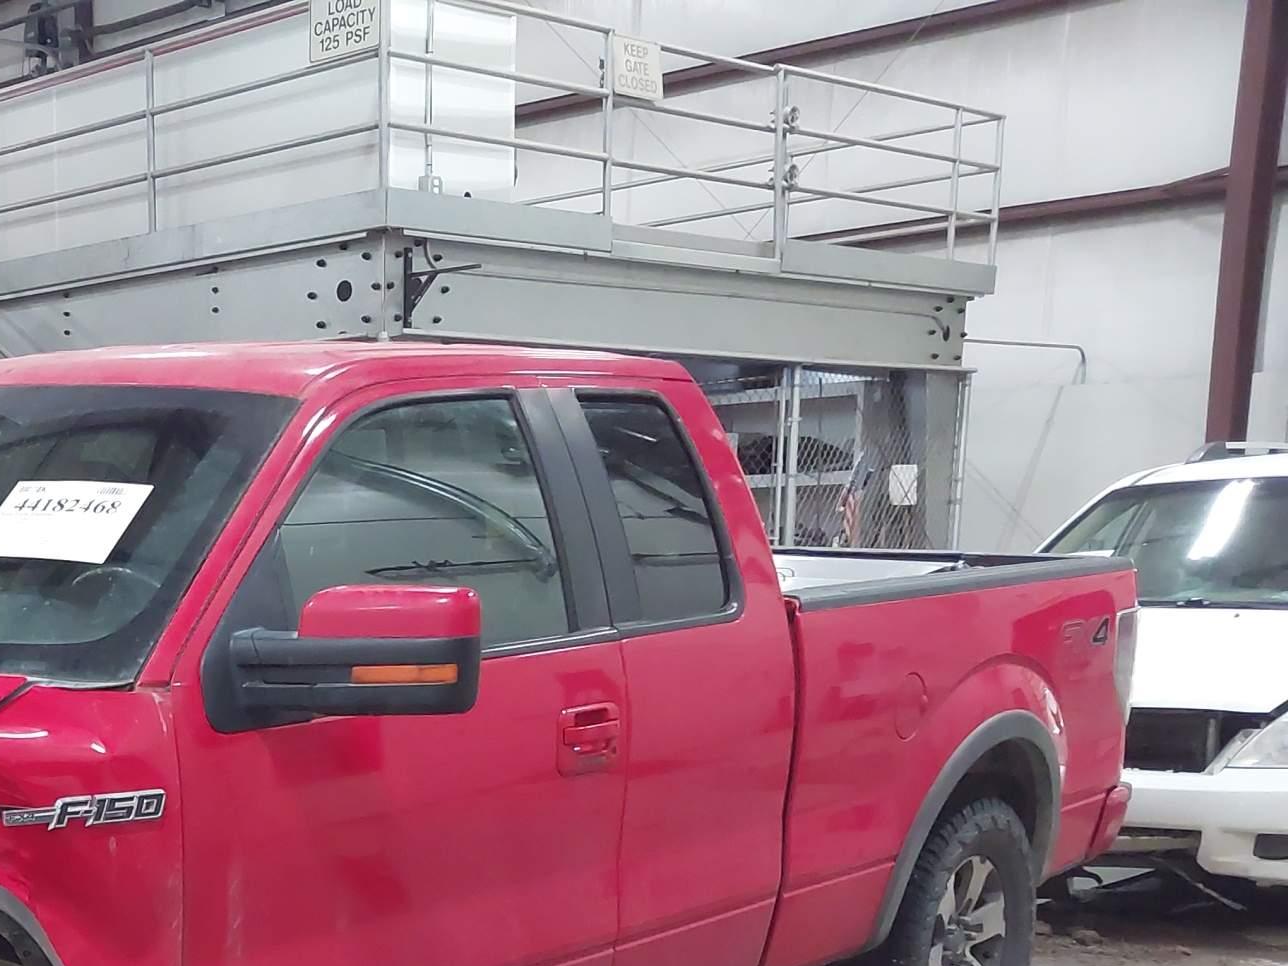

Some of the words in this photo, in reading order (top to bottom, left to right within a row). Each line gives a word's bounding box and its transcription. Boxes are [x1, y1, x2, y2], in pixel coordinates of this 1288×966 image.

[328, 0, 362, 15] LOAD
[314, 6, 376, 36] CAPACITY
[319, 34, 340, 52] 125
[345, 25, 370, 46] PSF
[623, 42, 649, 59] KEEP
[624, 58, 649, 77] GATE
[618, 73, 658, 94] CLOSED
[14, 498, 122, 514] 44182468
[48, 789, 166, 831] F-150
